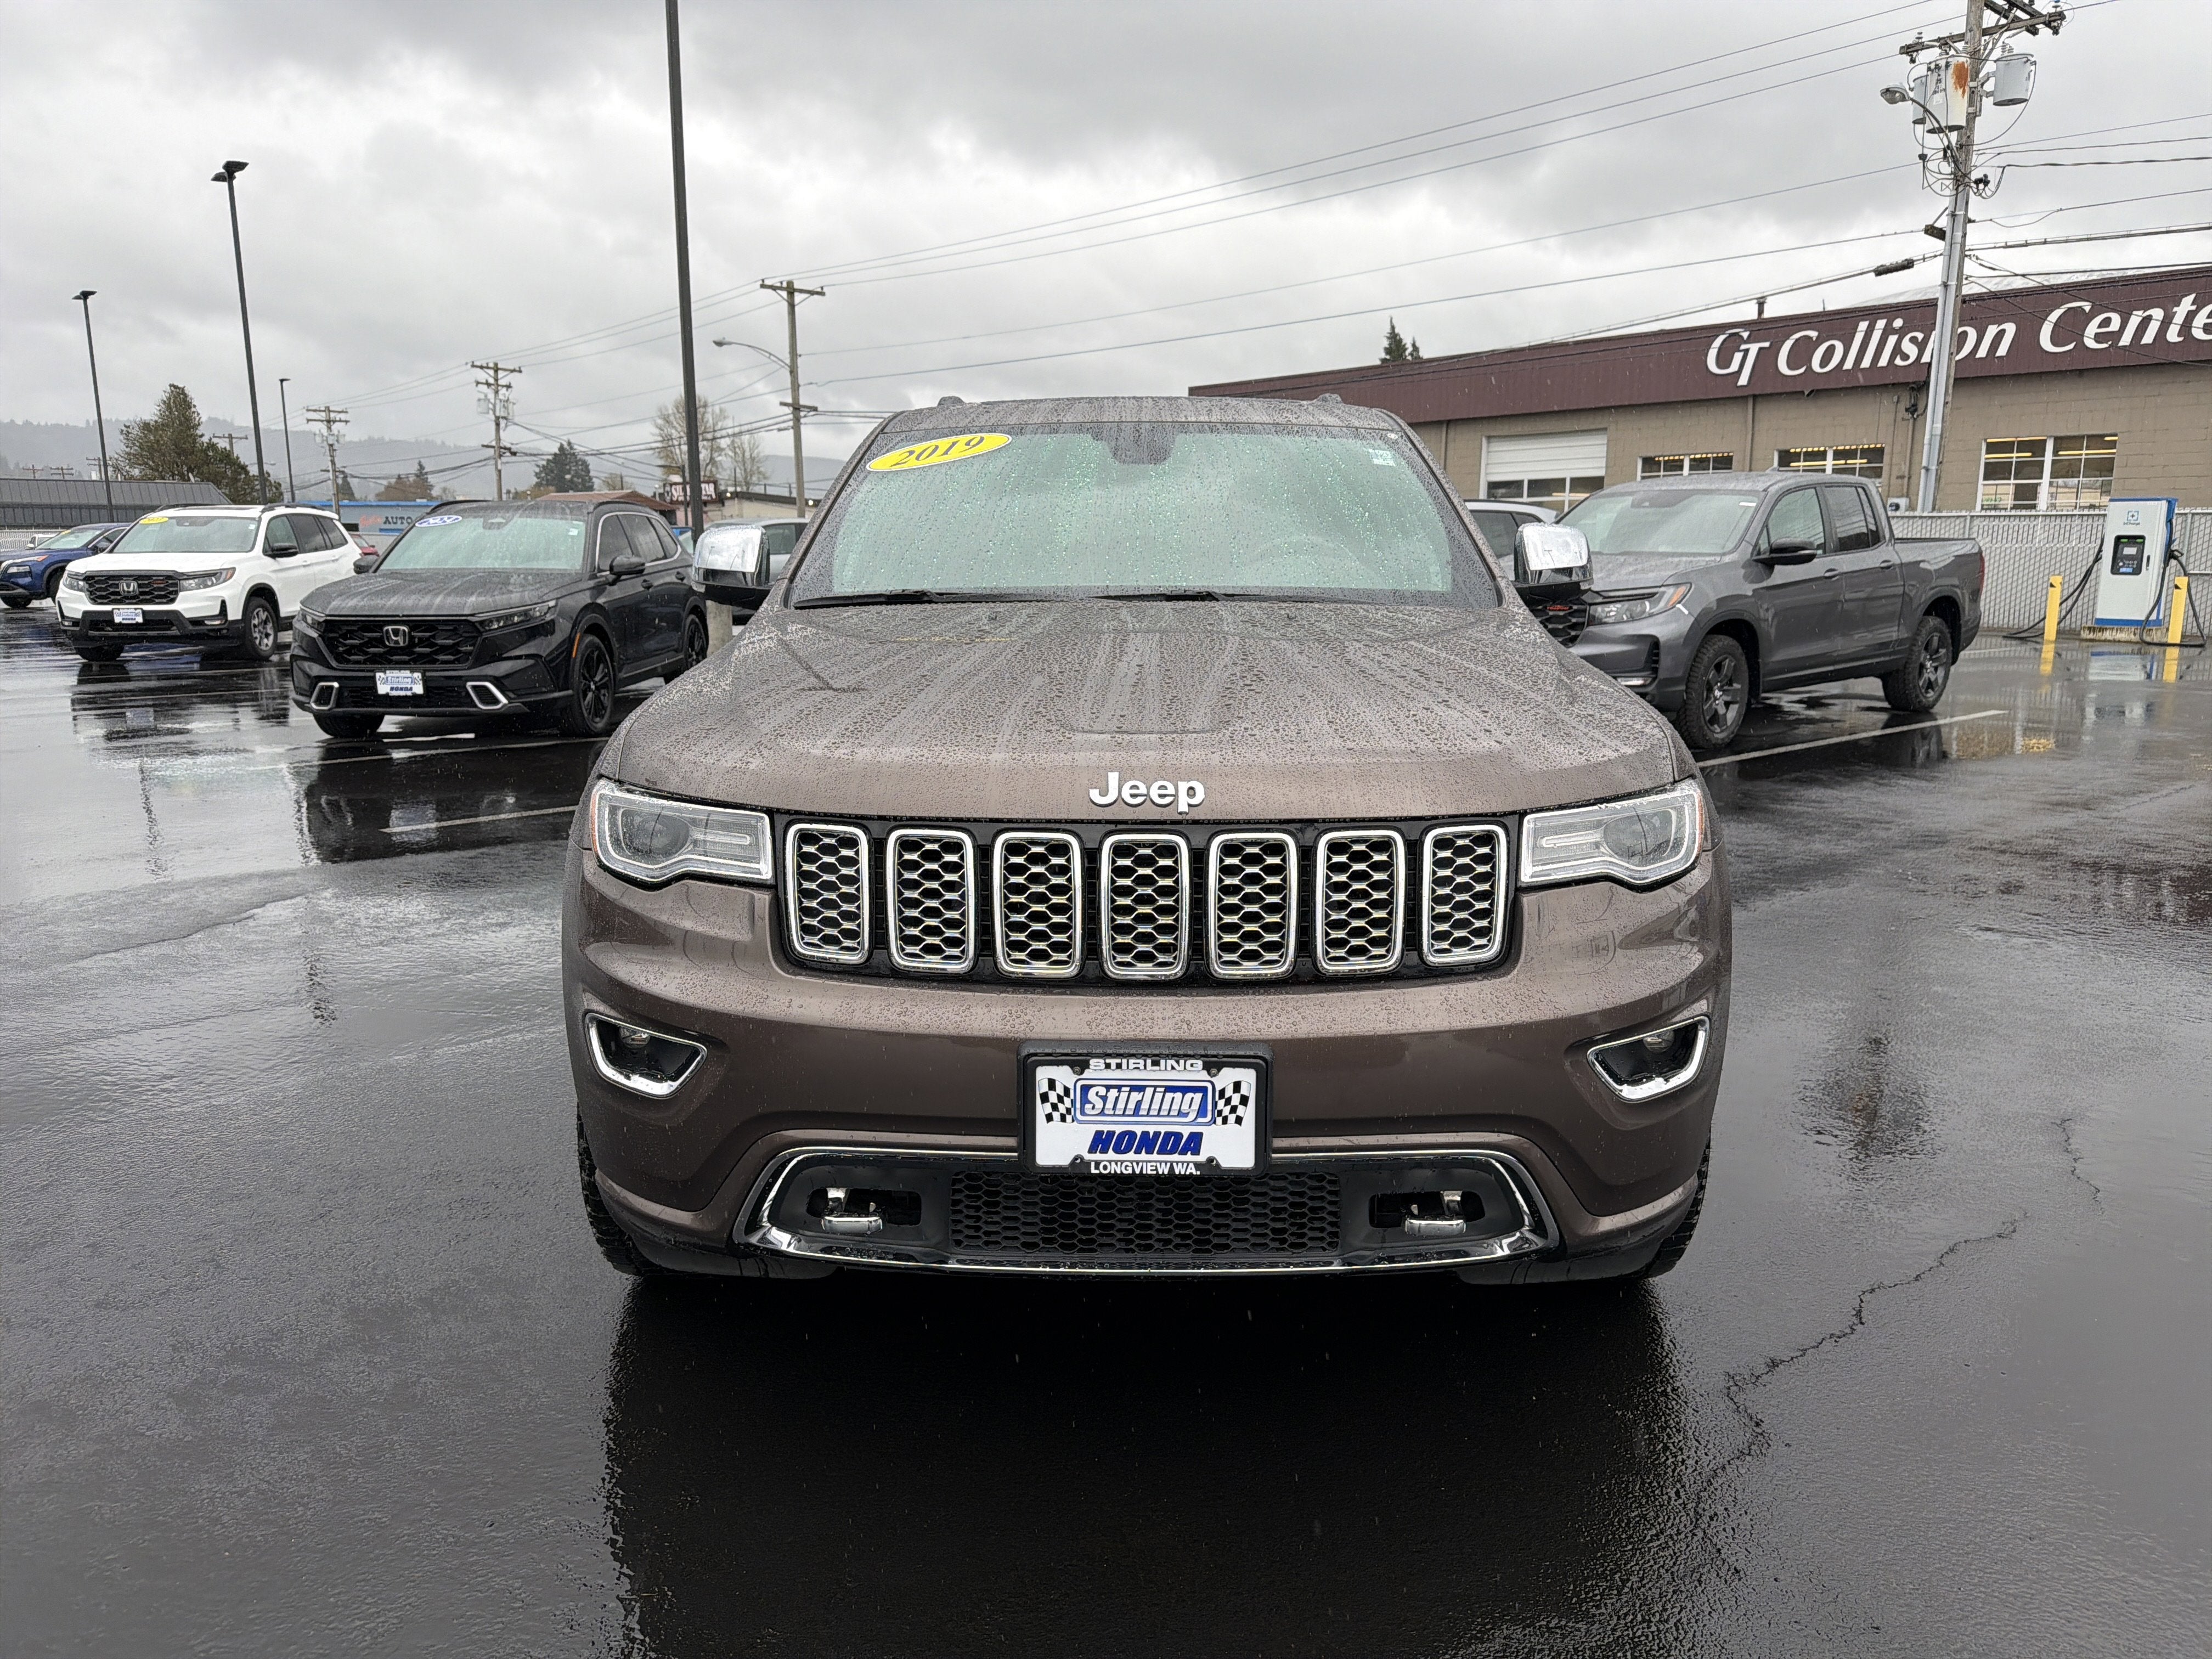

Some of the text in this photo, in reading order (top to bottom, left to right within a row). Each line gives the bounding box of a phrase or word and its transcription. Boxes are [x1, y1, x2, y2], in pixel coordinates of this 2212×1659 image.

[1707, 328, 1771, 387] GT
[1777, 317, 2017, 377] Collision
[889, 435, 985, 467] 2019
[1088, 771, 1205, 815] Jeep
[1088, 1058, 1203, 1071] STIRLING
[1084, 1086, 1204, 1121] Stirling
[1087, 1130, 1204, 1156] HONDA
[1091, 1161, 1201, 1175] LONGVIEW WA.
